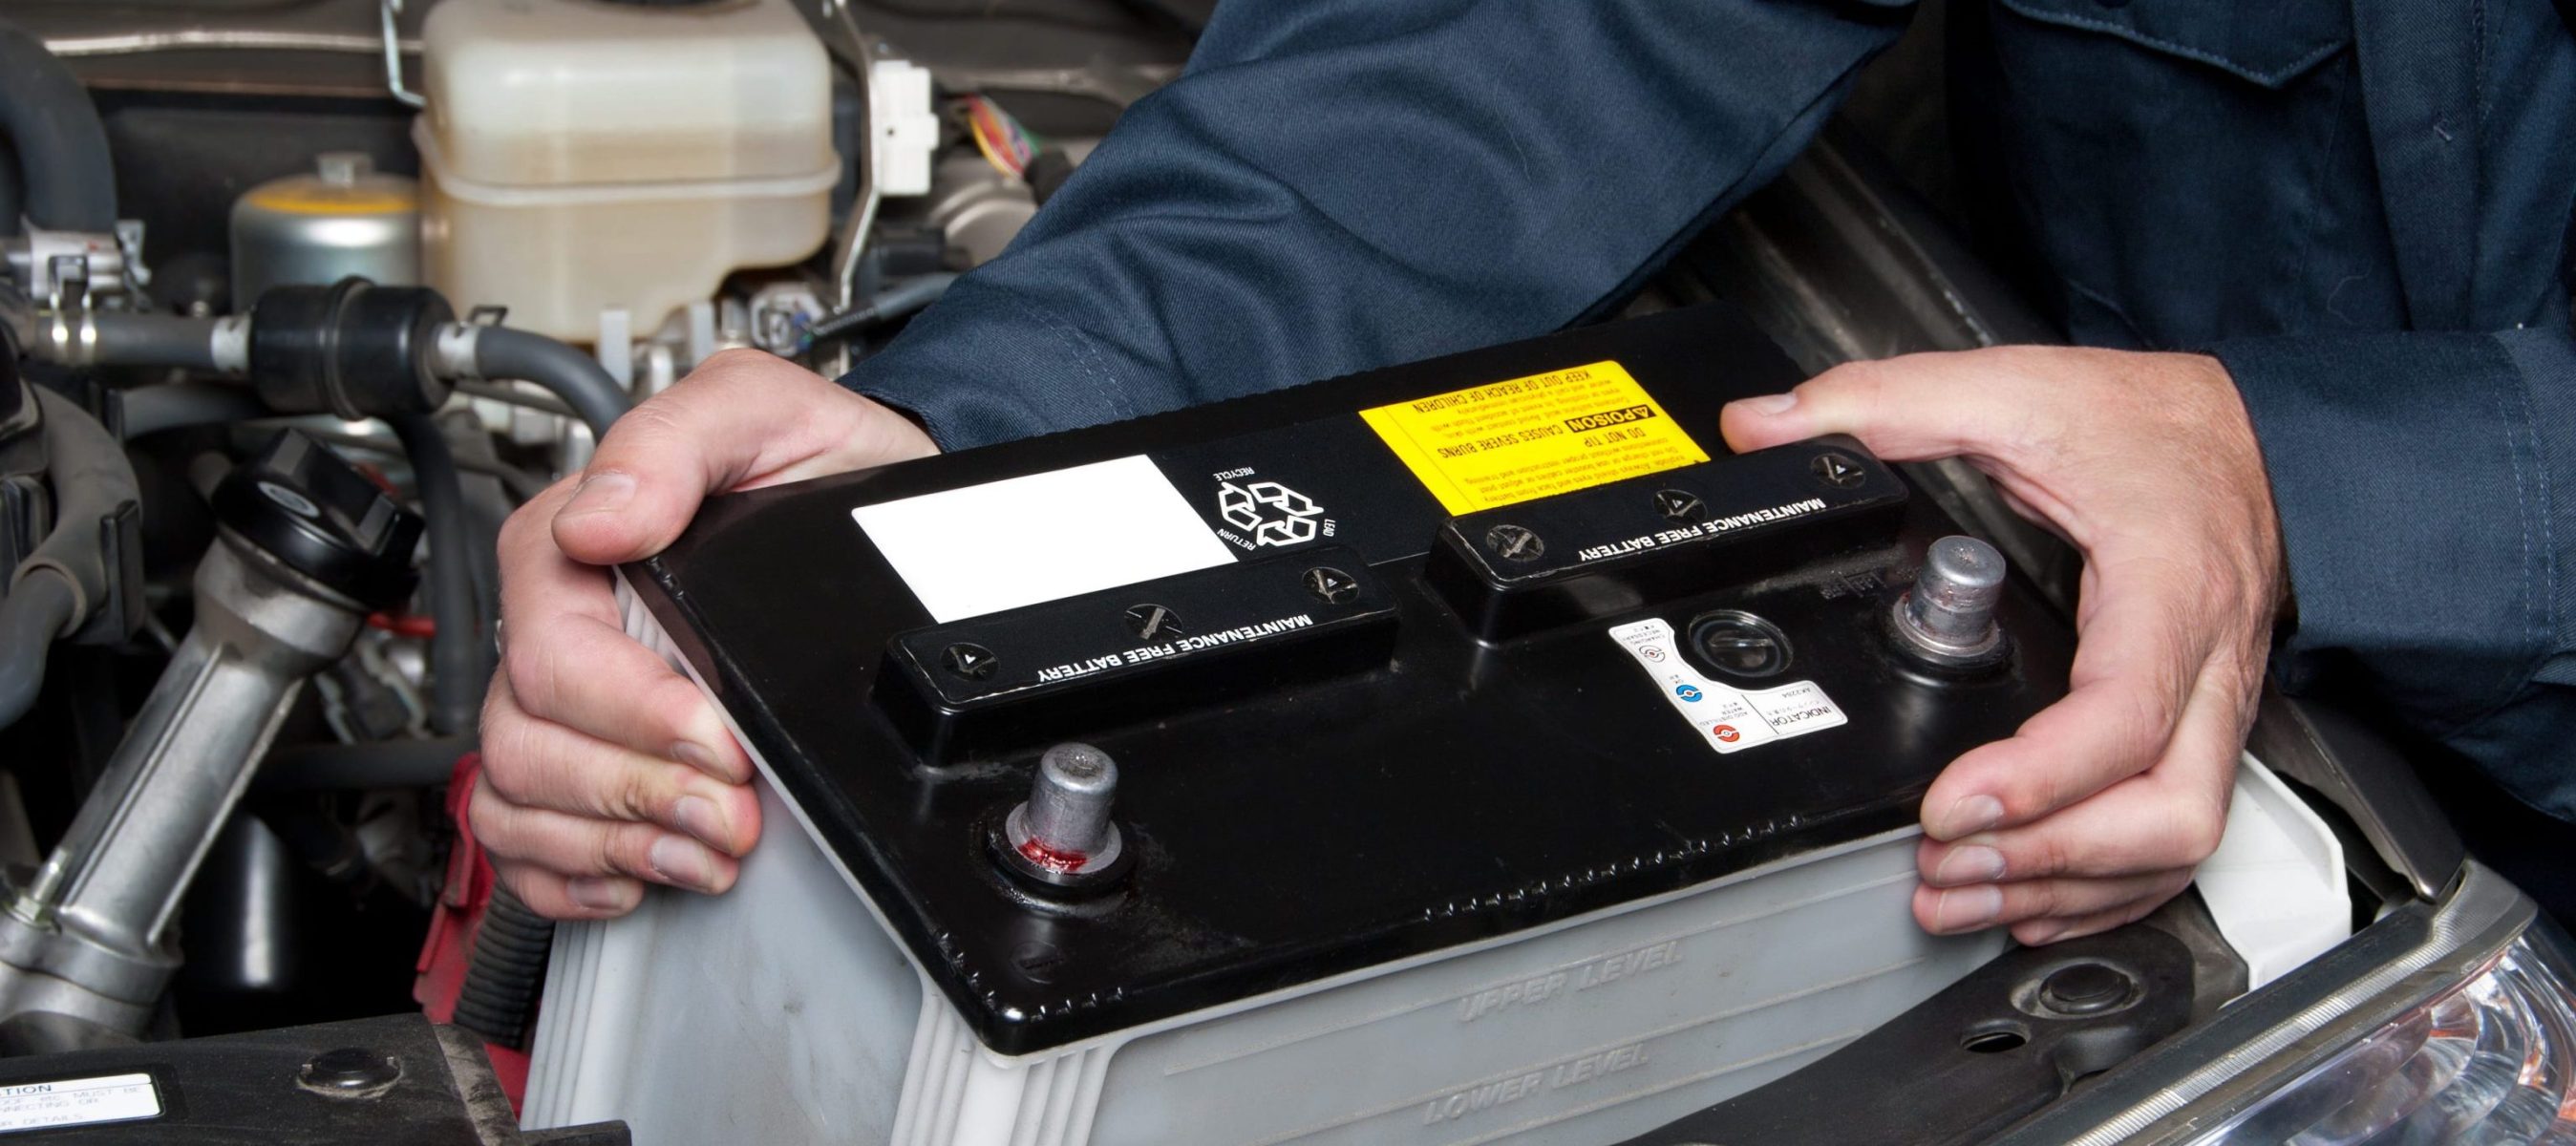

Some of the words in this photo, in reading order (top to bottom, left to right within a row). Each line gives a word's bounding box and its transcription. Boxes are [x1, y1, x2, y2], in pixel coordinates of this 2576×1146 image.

[1520, 379, 1541, 391] OF
[1537, 374, 1565, 388] OUT
[1560, 369, 1592, 383] KEEP
[1465, 390, 1486, 402] OF
[1482, 382, 1524, 398] REACH
[1410, 393, 1469, 414] CHILDREN
[1565, 408, 1638, 432] POISON
[1516, 423, 1565, 441] CAUSES
[1600, 430, 1629, 443] NOT
[1624, 426, 1647, 438] DO
[1435, 441, 1479, 458] BURNS
[1474, 433, 1521, 451] SEVERE
[1579, 435, 1605, 448] TIP
[1213, 467, 1256, 481] RECYCLE
[1702, 498, 1826, 535] MAINTENANCE
[1323, 519, 1335, 537] LEAD
[1655, 523, 1701, 546] FREE
[1217, 528, 1256, 551] RETURN
[1577, 535, 1653, 562] BATTERY
[1176, 613, 1312, 652] MAINTENANCE
[1123, 640, 1175, 664] FREE
[1036, 653, 1121, 683] BATTERY
[1767, 705, 1832, 727] INDICATOR
[1458, 972, 1566, 1023] UPPER
[1577, 941, 1682, 991] LEVEL
[0, 1085, 52, 1095] TION
[1423, 1072, 1543, 1125] LOWER
[1552, 1044, 1649, 1089] LEVEL
